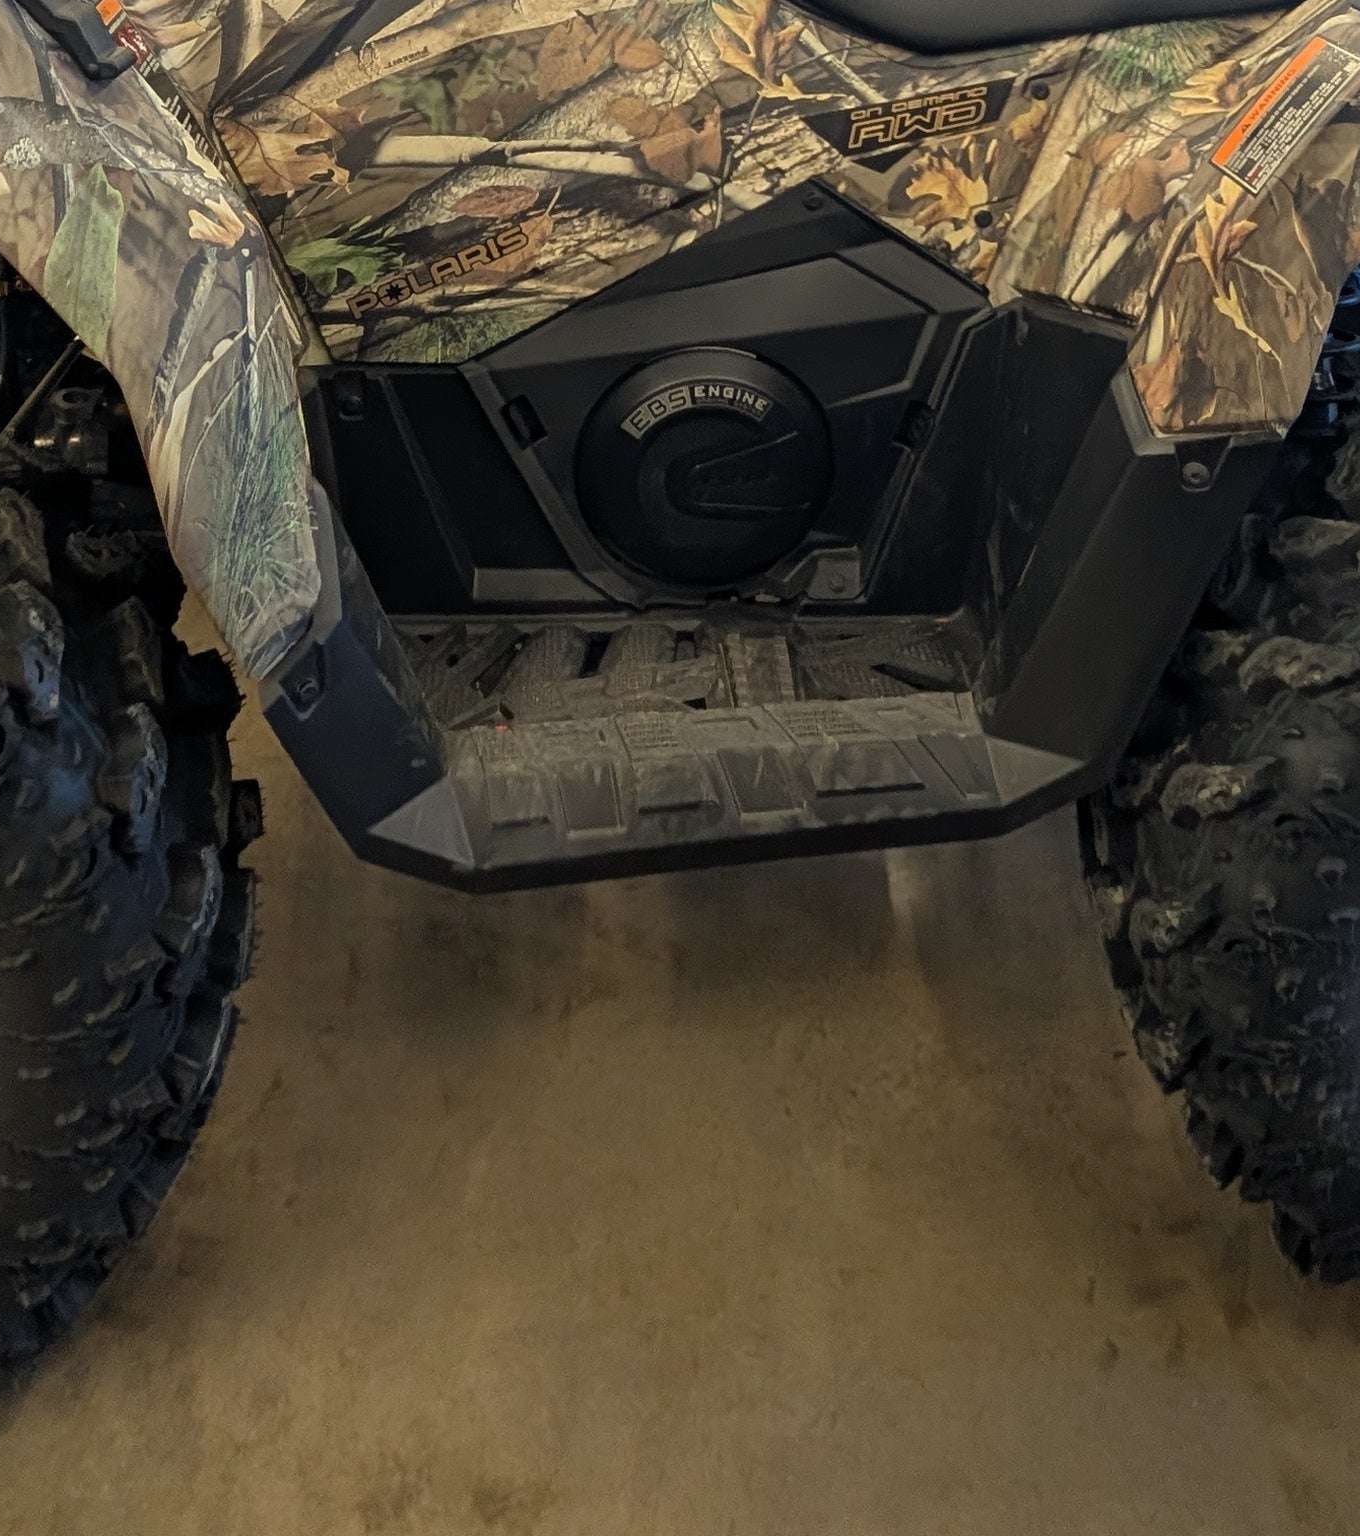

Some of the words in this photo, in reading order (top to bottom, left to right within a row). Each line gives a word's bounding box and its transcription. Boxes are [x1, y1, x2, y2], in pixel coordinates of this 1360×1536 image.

[1247, 66, 1298, 121] WARNING
[848, 98, 987, 149] AWD
[346, 225, 529, 321] POLARIS
[629, 388, 687, 432] EBS
[694, 384, 768, 412] ENGINE
